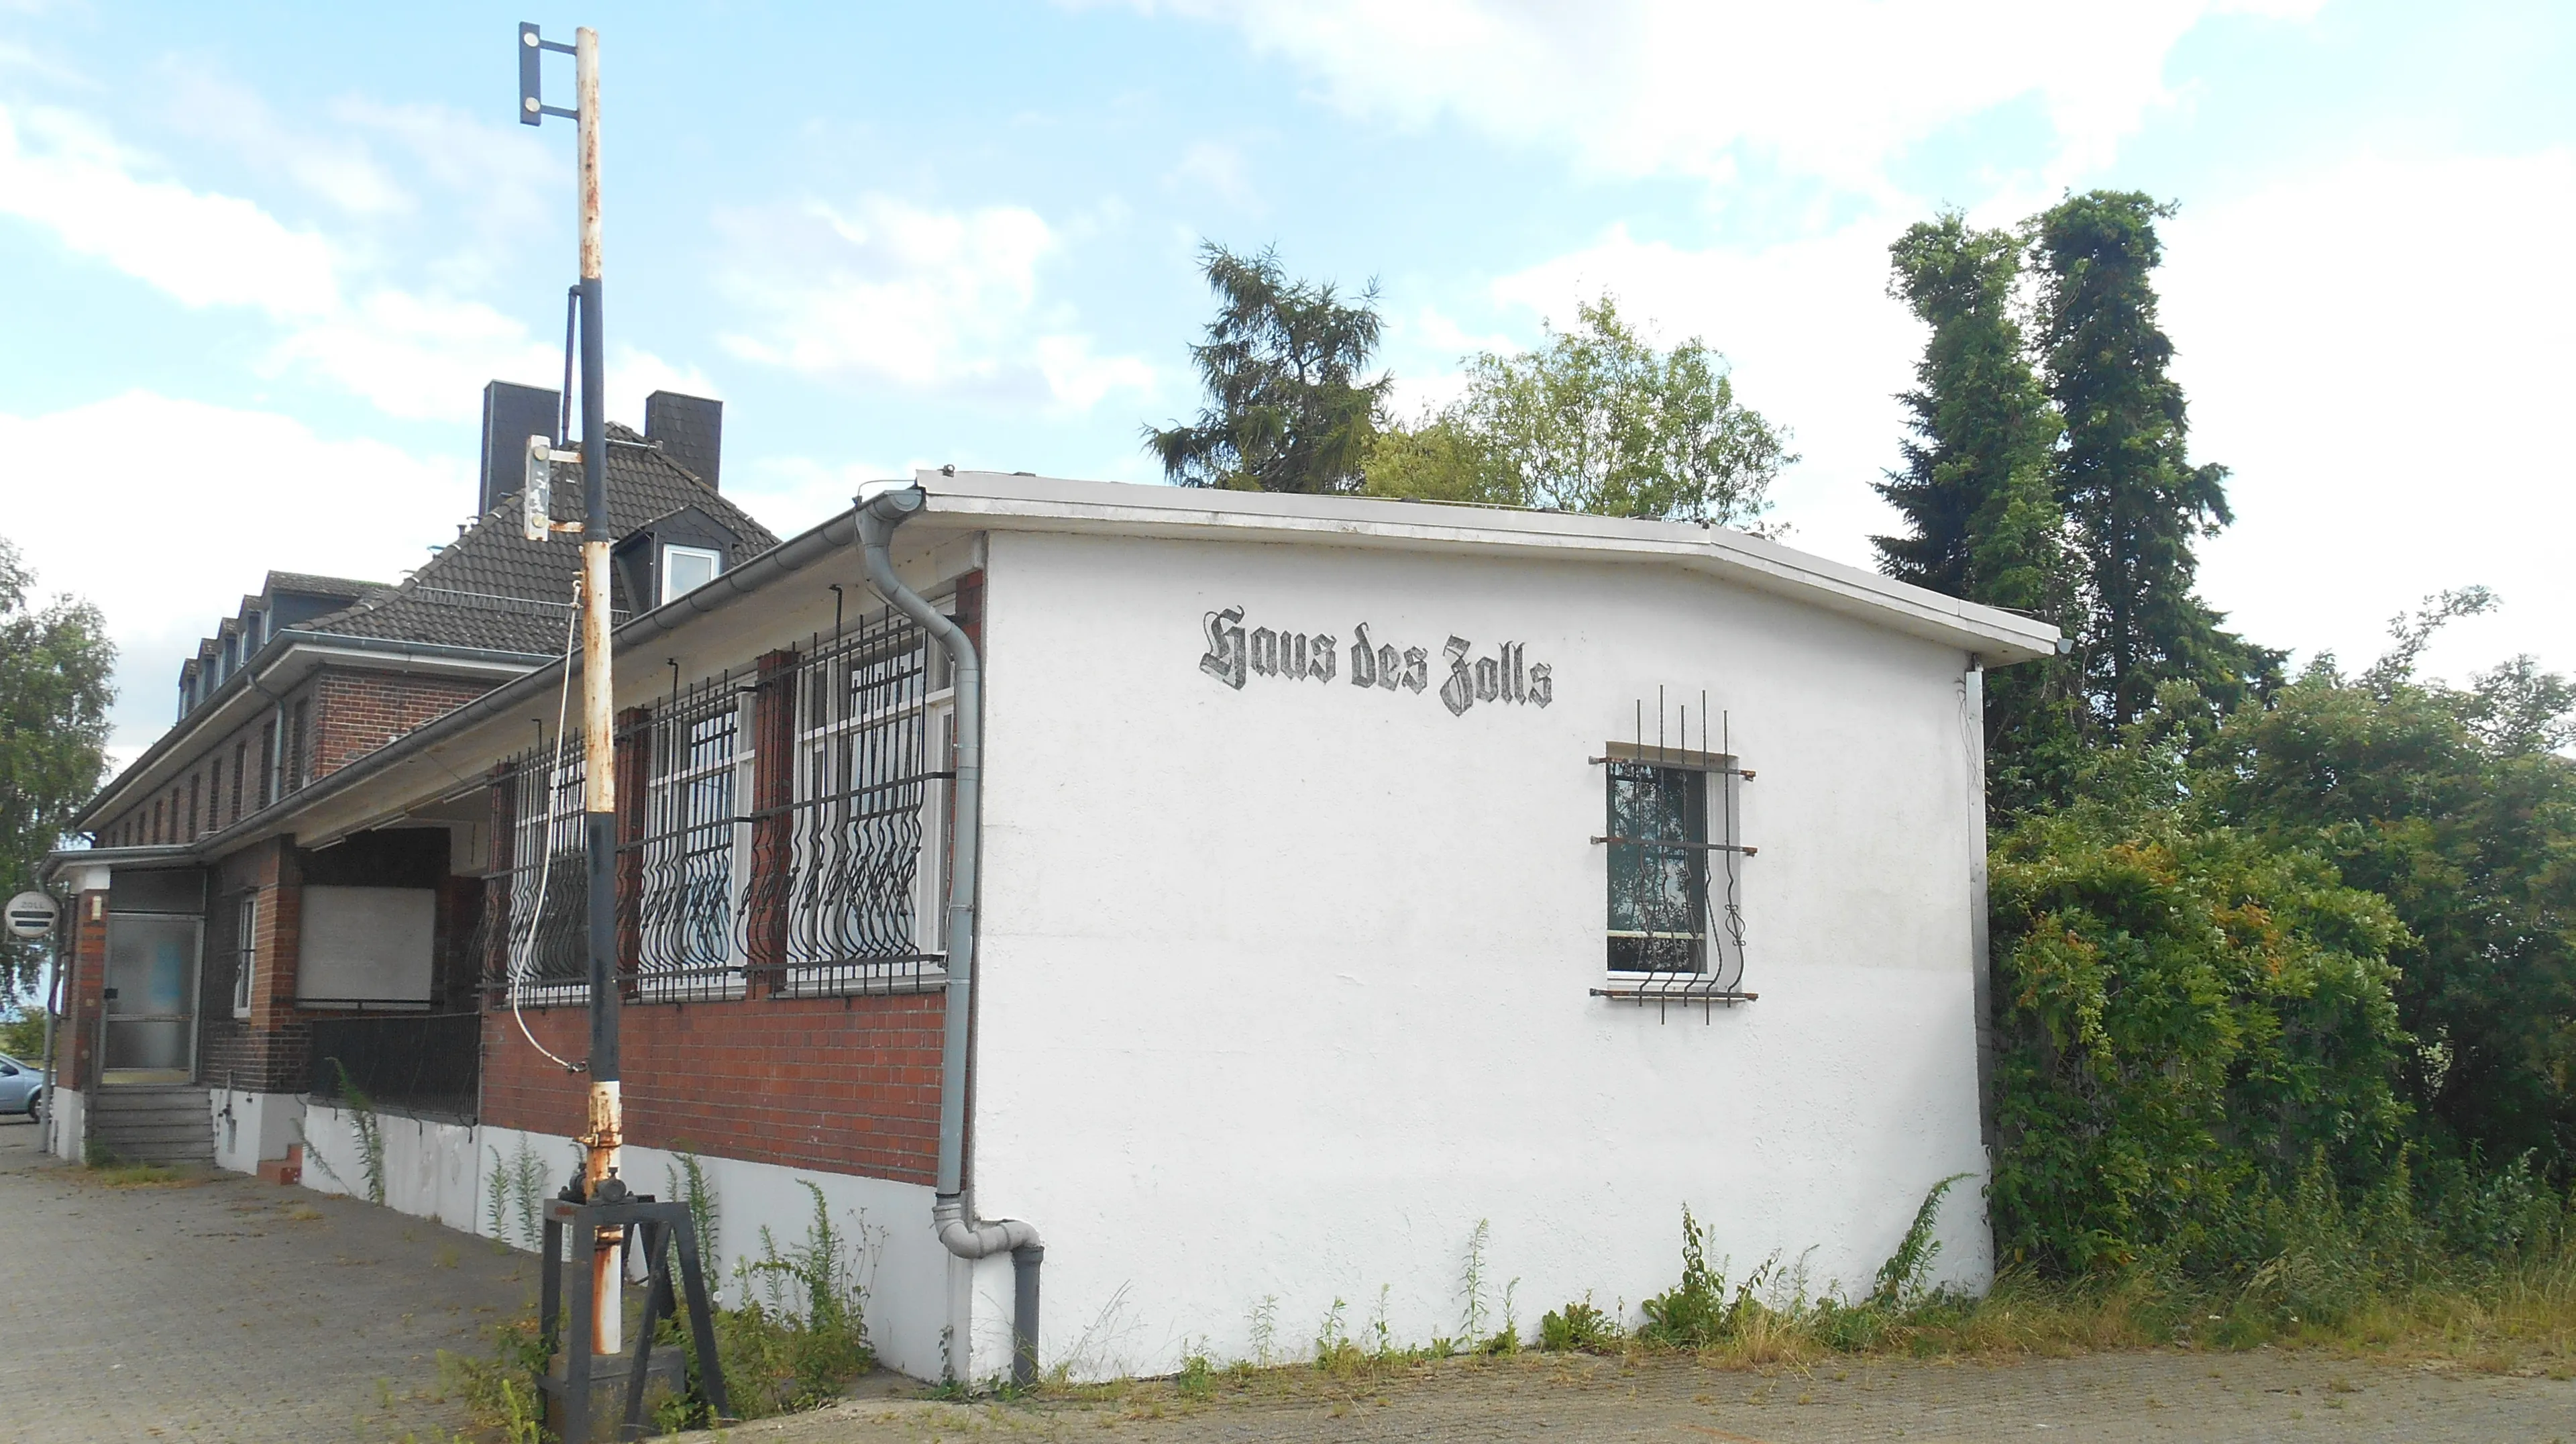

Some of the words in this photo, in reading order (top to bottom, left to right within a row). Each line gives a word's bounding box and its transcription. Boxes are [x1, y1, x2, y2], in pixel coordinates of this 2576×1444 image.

[1199, 605, 1337, 690] Haus
[1350, 621, 1428, 695] des
[1440, 634, 1553, 717] Zolls
